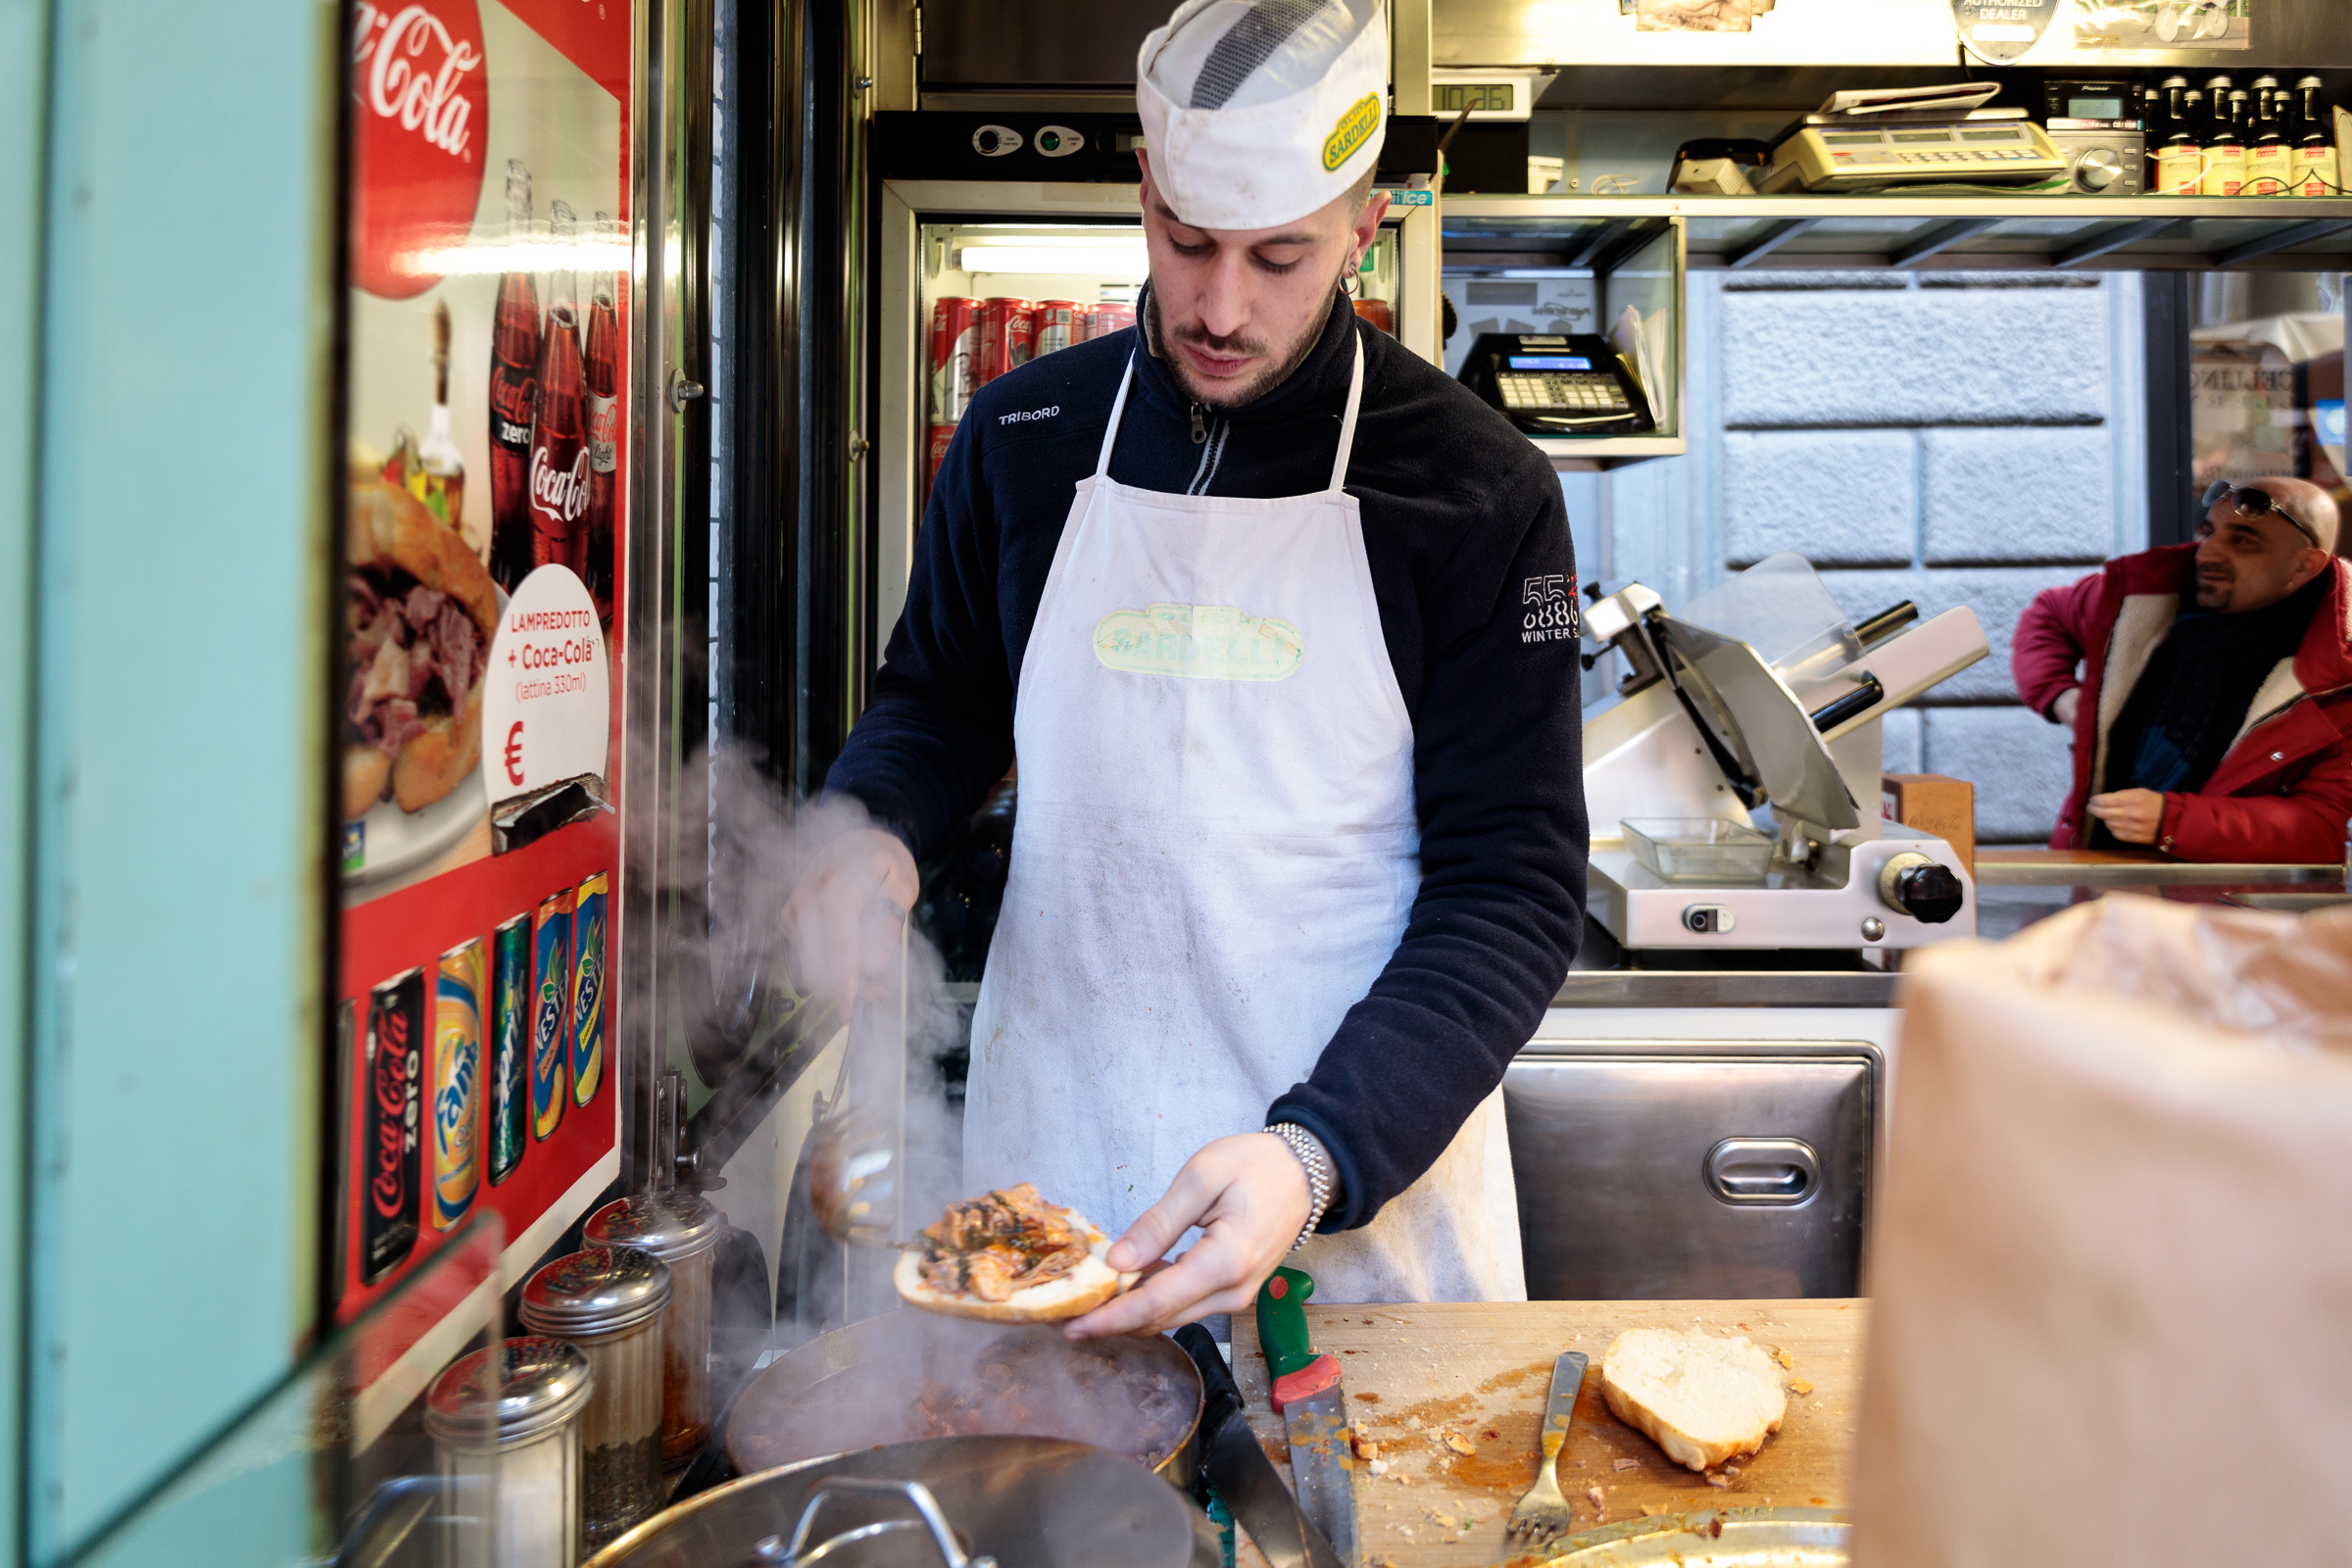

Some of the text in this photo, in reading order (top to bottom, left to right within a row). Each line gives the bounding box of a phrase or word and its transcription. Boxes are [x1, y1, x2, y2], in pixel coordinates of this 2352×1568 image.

[1980, 8, 2027, 21] DEALER
[1328, 102, 1378, 165] SARDELLI
[999, 405, 1060, 425] TRIBORD
[501, 420, 531, 445] zero
[594, 445, 612, 467] light
[511, 610, 591, 634] LAMPREDOTTO
[1522, 628, 1571, 644] WINTER
[522, 638, 593, 670] Coca-Cola
[1111, 627, 1285, 665] SARDELLI
[515, 671, 587, 704] (lattina 330ml)
[372, 1009, 410, 1218] Coca-Cola
[405, 1049, 419, 1154] zero
